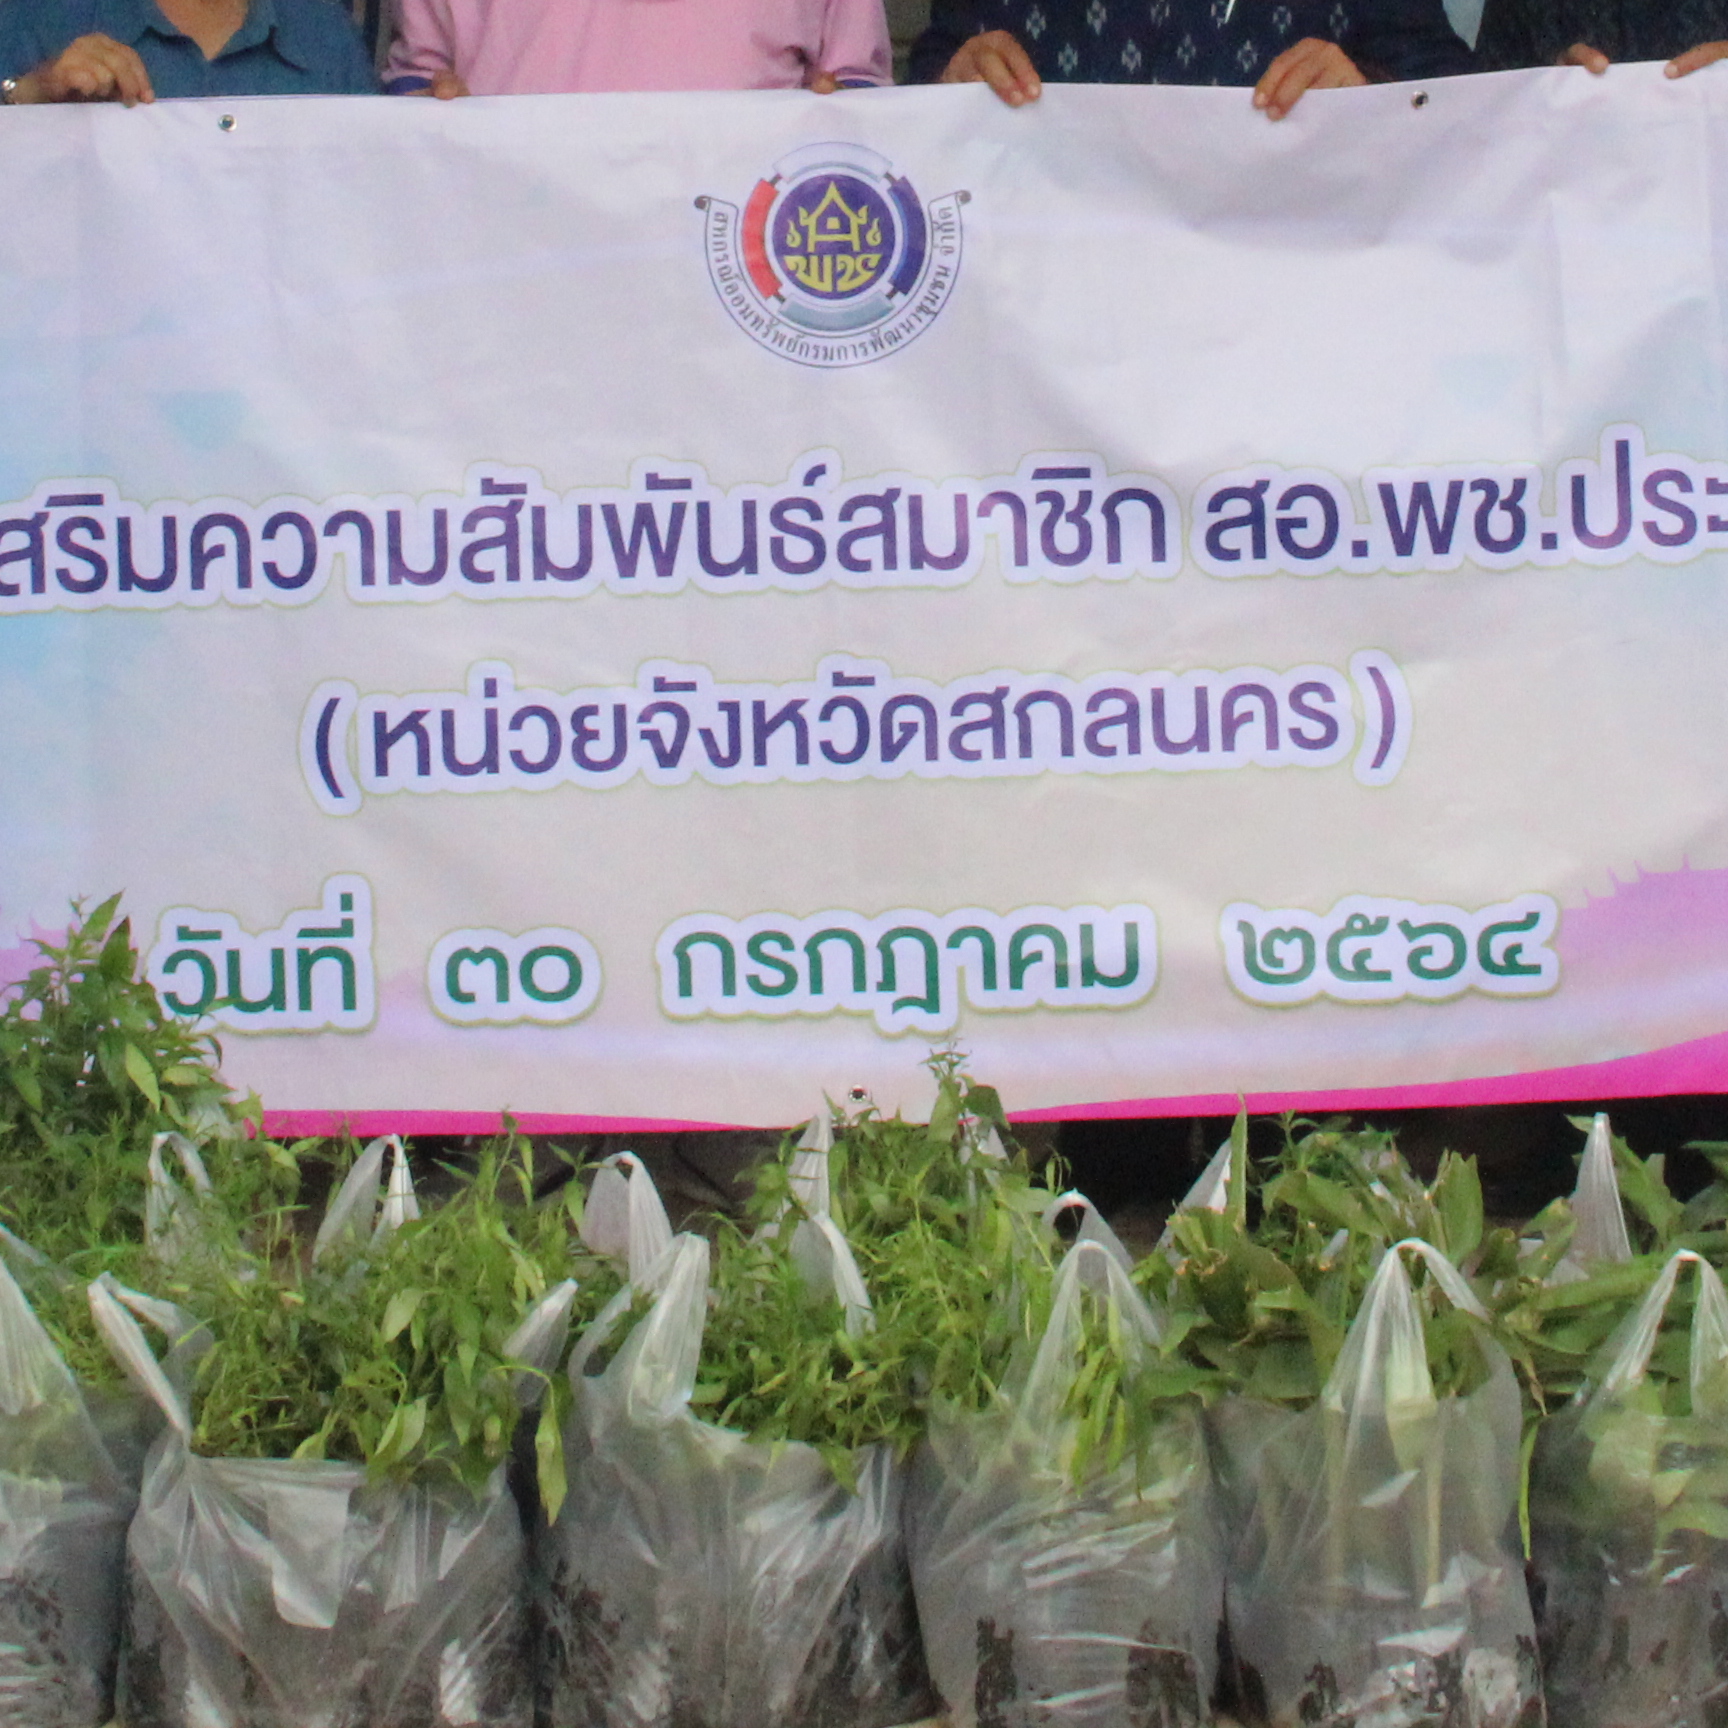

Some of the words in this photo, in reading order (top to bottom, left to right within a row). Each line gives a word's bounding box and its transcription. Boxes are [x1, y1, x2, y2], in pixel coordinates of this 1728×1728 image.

[314, 665, 1395, 798] (หน่วยจังหวัดสกลนคร)
[161, 893, 357, 1016] วันที่
[444, 946, 583, 1006] ๓๐
[672, 916, 1141, 1015] กรกฎาคม
[1236, 911, 1542, 985] ๒๕๖๔
